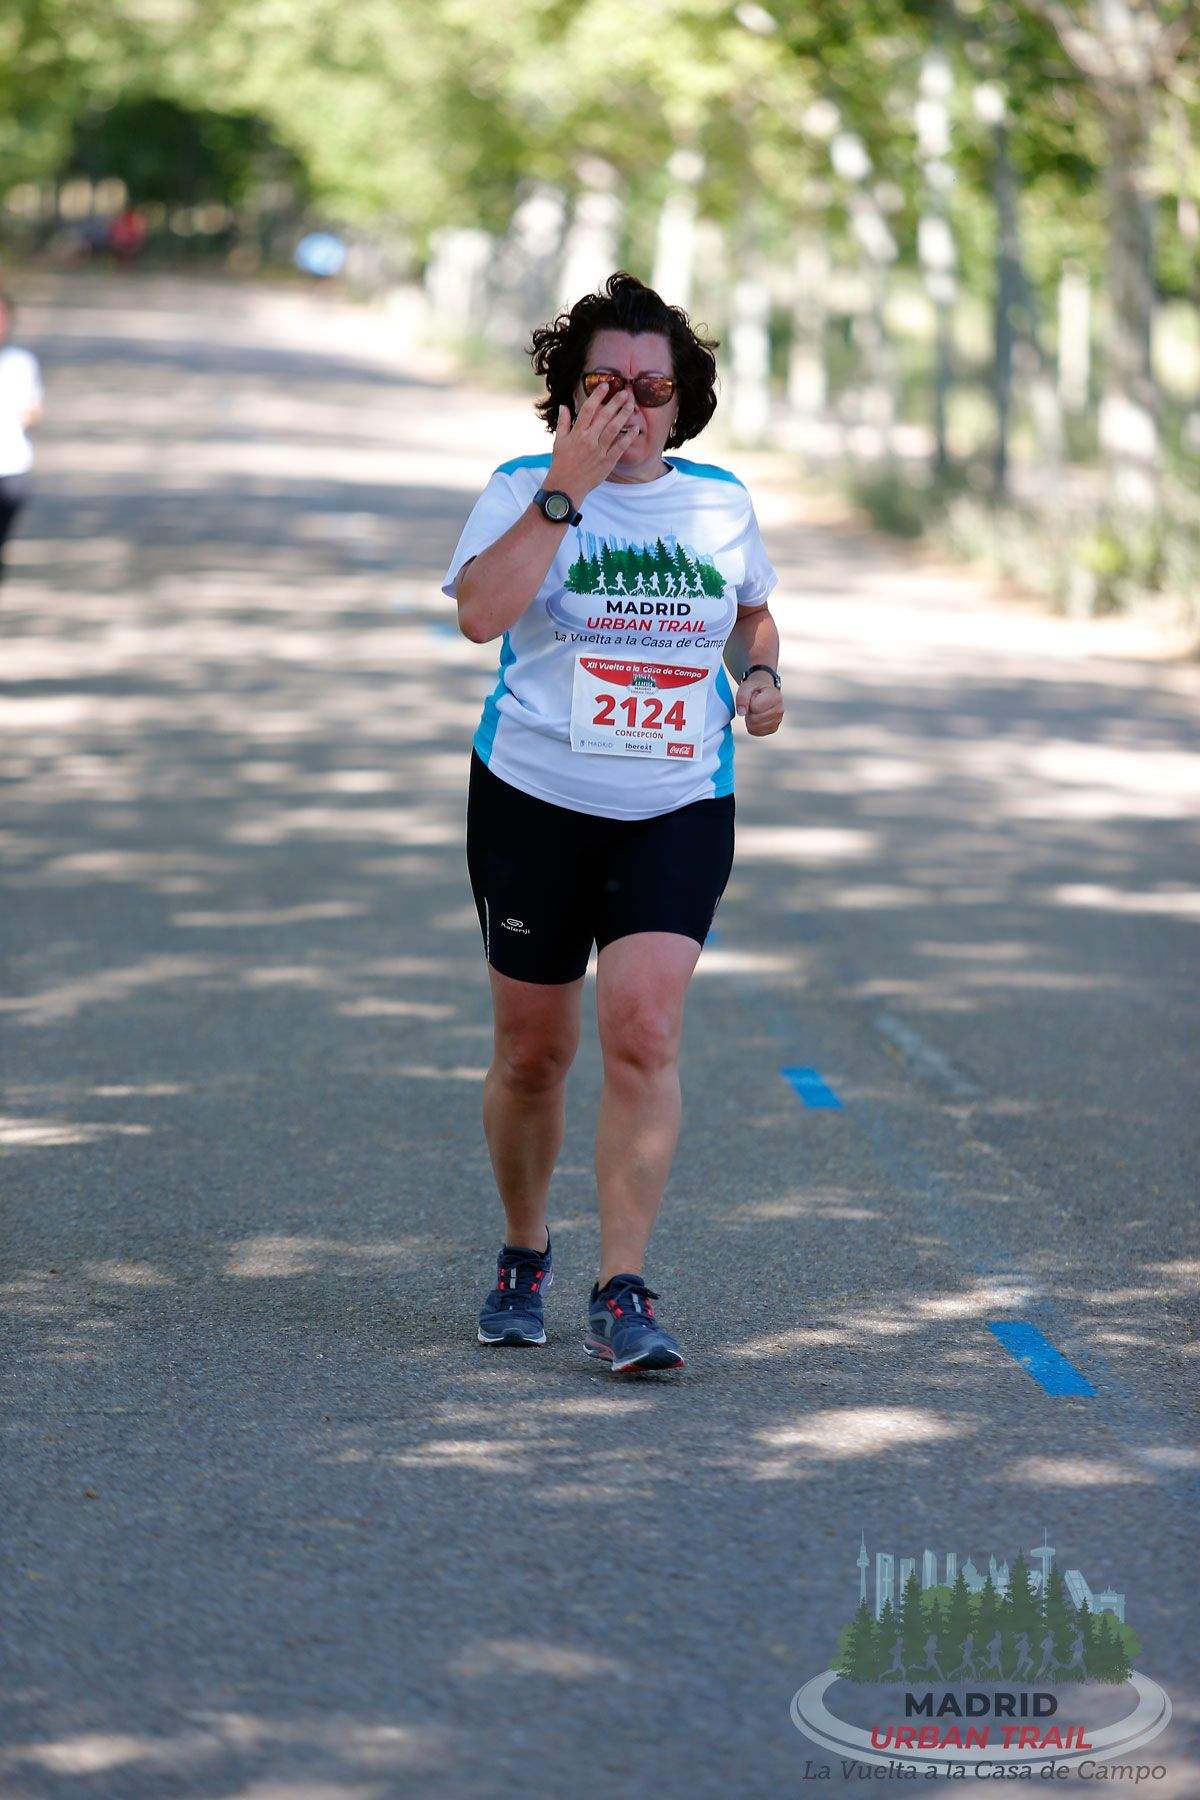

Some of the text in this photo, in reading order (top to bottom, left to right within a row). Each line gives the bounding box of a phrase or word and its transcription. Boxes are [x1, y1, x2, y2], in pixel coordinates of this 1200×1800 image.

[606, 600, 691, 616] MADRID
[587, 617, 707, 633] URBAN TRAIL
[554, 631, 567, 643] La
[570, 632, 611, 645] Vuelta
[614, 636, 622, 645] a
[625, 634, 637, 646] la
[641, 636, 672, 648] Casa
[676, 637, 692, 648] de
[586, 661, 597, 669] XII
[599, 662, 624, 671] Vuelta
[632, 664, 640, 672] la
[642, 666, 661, 674] Casa
[663, 666, 673, 675] de
[674, 669, 702, 679] Campo
[592, 694, 686, 731] 2124
[615, 729, 664, 739] CONCEPCIÓN
[588, 740, 614, 749] MADRID
